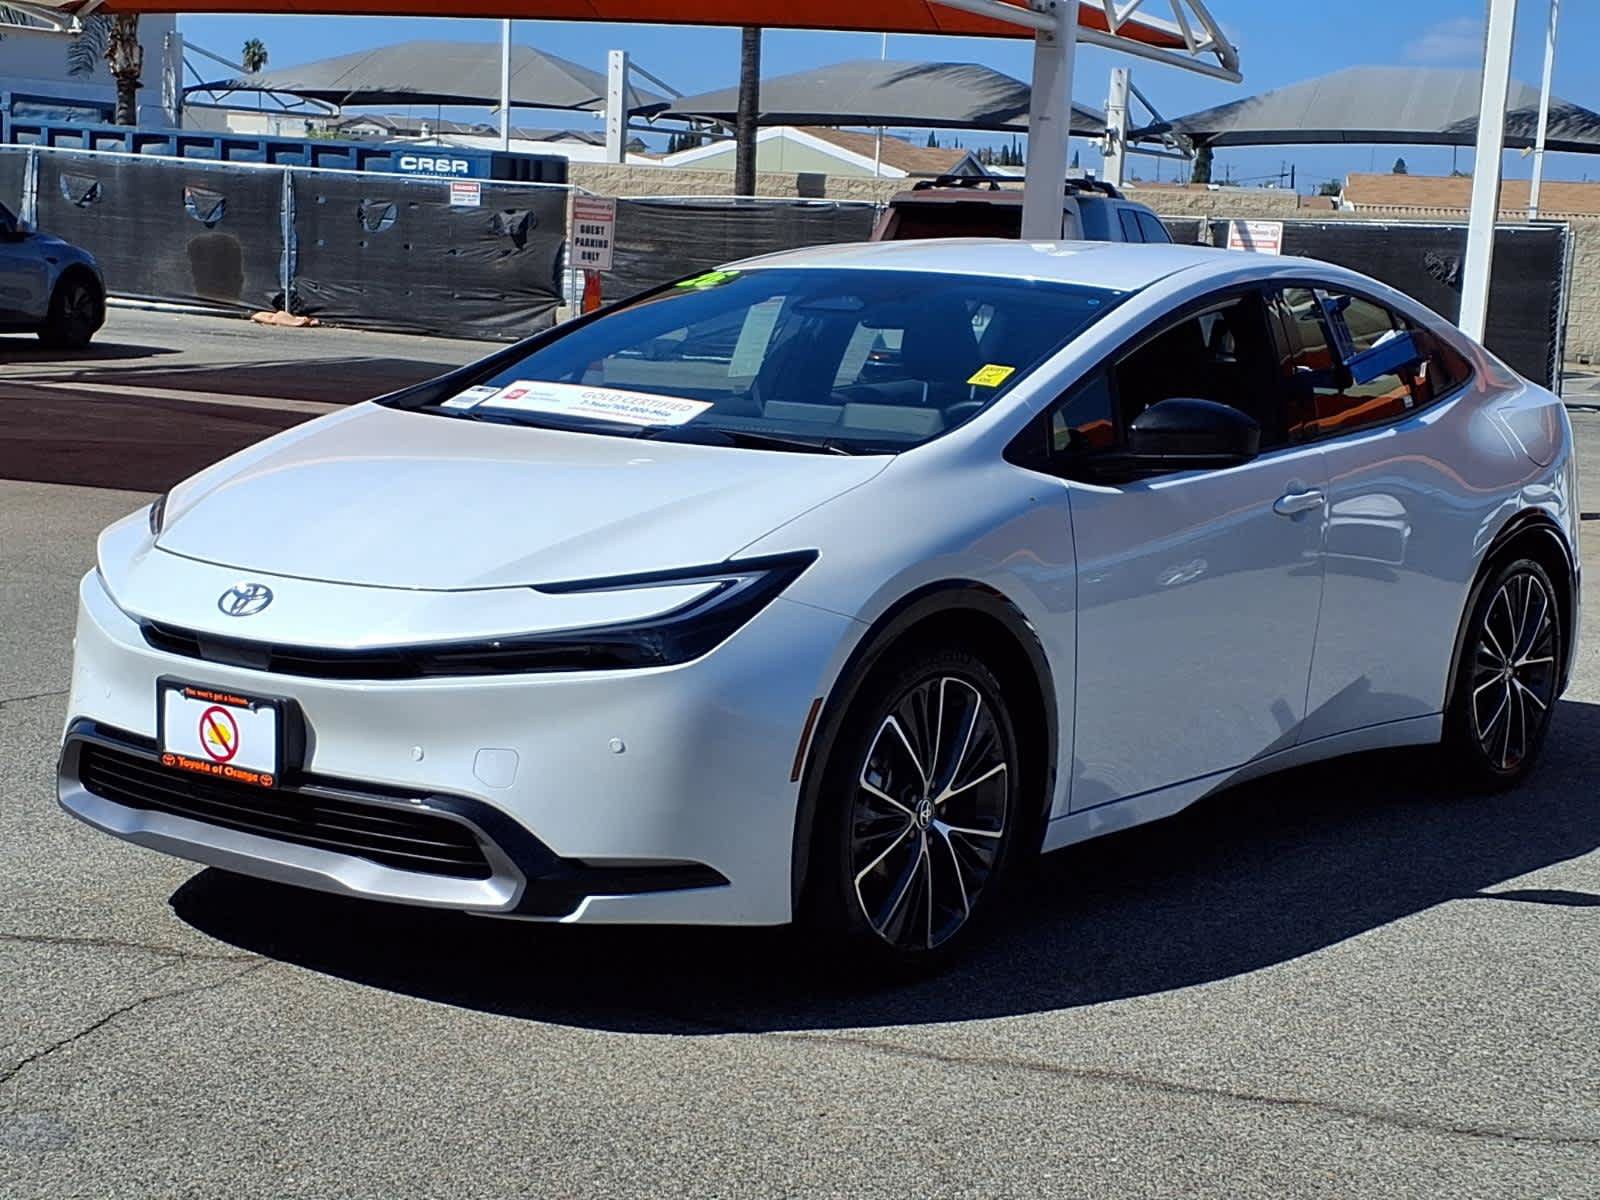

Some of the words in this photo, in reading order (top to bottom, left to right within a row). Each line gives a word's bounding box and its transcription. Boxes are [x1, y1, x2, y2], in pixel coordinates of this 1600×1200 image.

[400, 156, 469, 174] CR&R
[580, 224, 605, 235] GUEST
[575, 237, 609, 249] PARKING
[581, 251, 600, 261] ONLY
[581, 391, 622, 401] GOLD
[621, 396, 693, 412] CERTIFIED
[177, 756, 210, 772] Toyota
[212, 765, 224, 775] of
[224, 766, 259, 782] Orange
